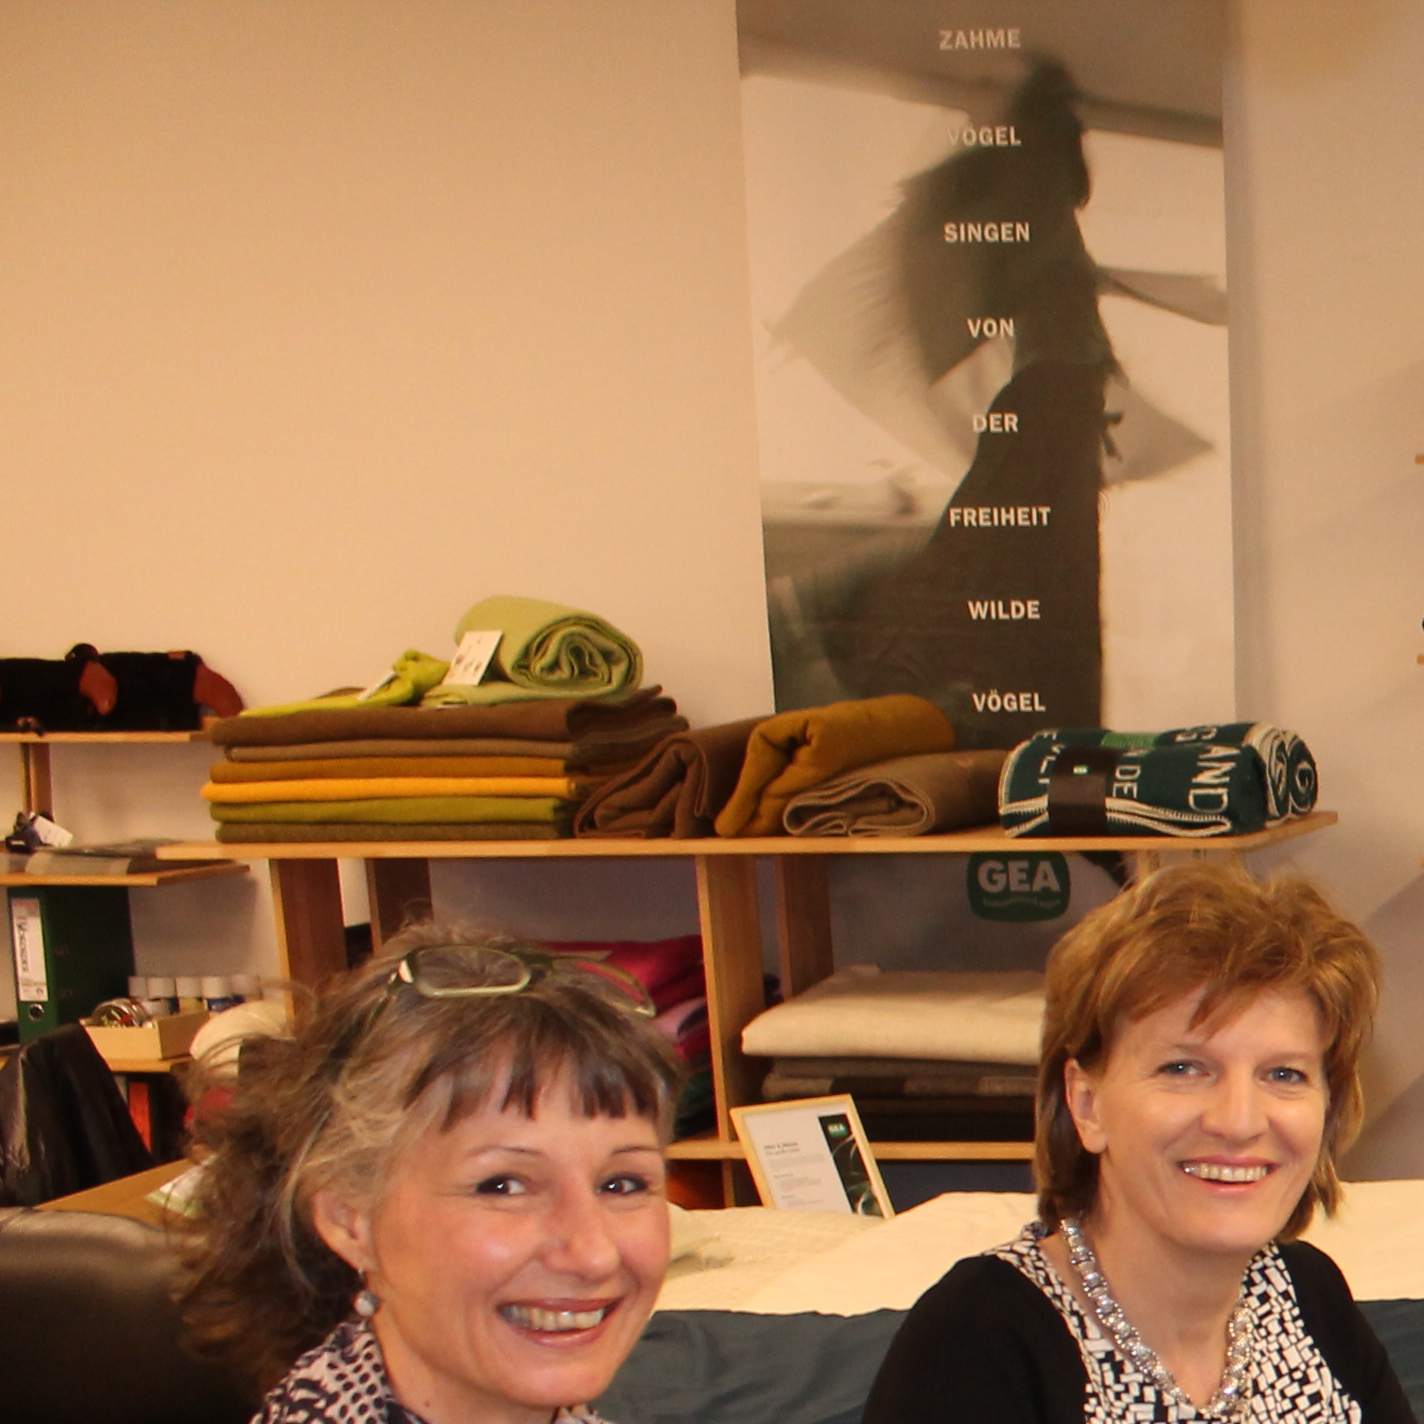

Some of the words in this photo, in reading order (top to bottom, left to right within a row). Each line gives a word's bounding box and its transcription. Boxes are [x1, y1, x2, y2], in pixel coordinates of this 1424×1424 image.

[938, 28, 1021, 50] ZAHME
[943, 222, 1031, 243] SINGEN
[966, 317, 1015, 338] VON
[972, 412, 1019, 433] DER
[949, 506, 1051, 527] FREIHEIT
[968, 599, 1041, 620] WILDE
[972, 689, 1046, 712] VÖGEL
[977, 859, 1061, 894] GEA
